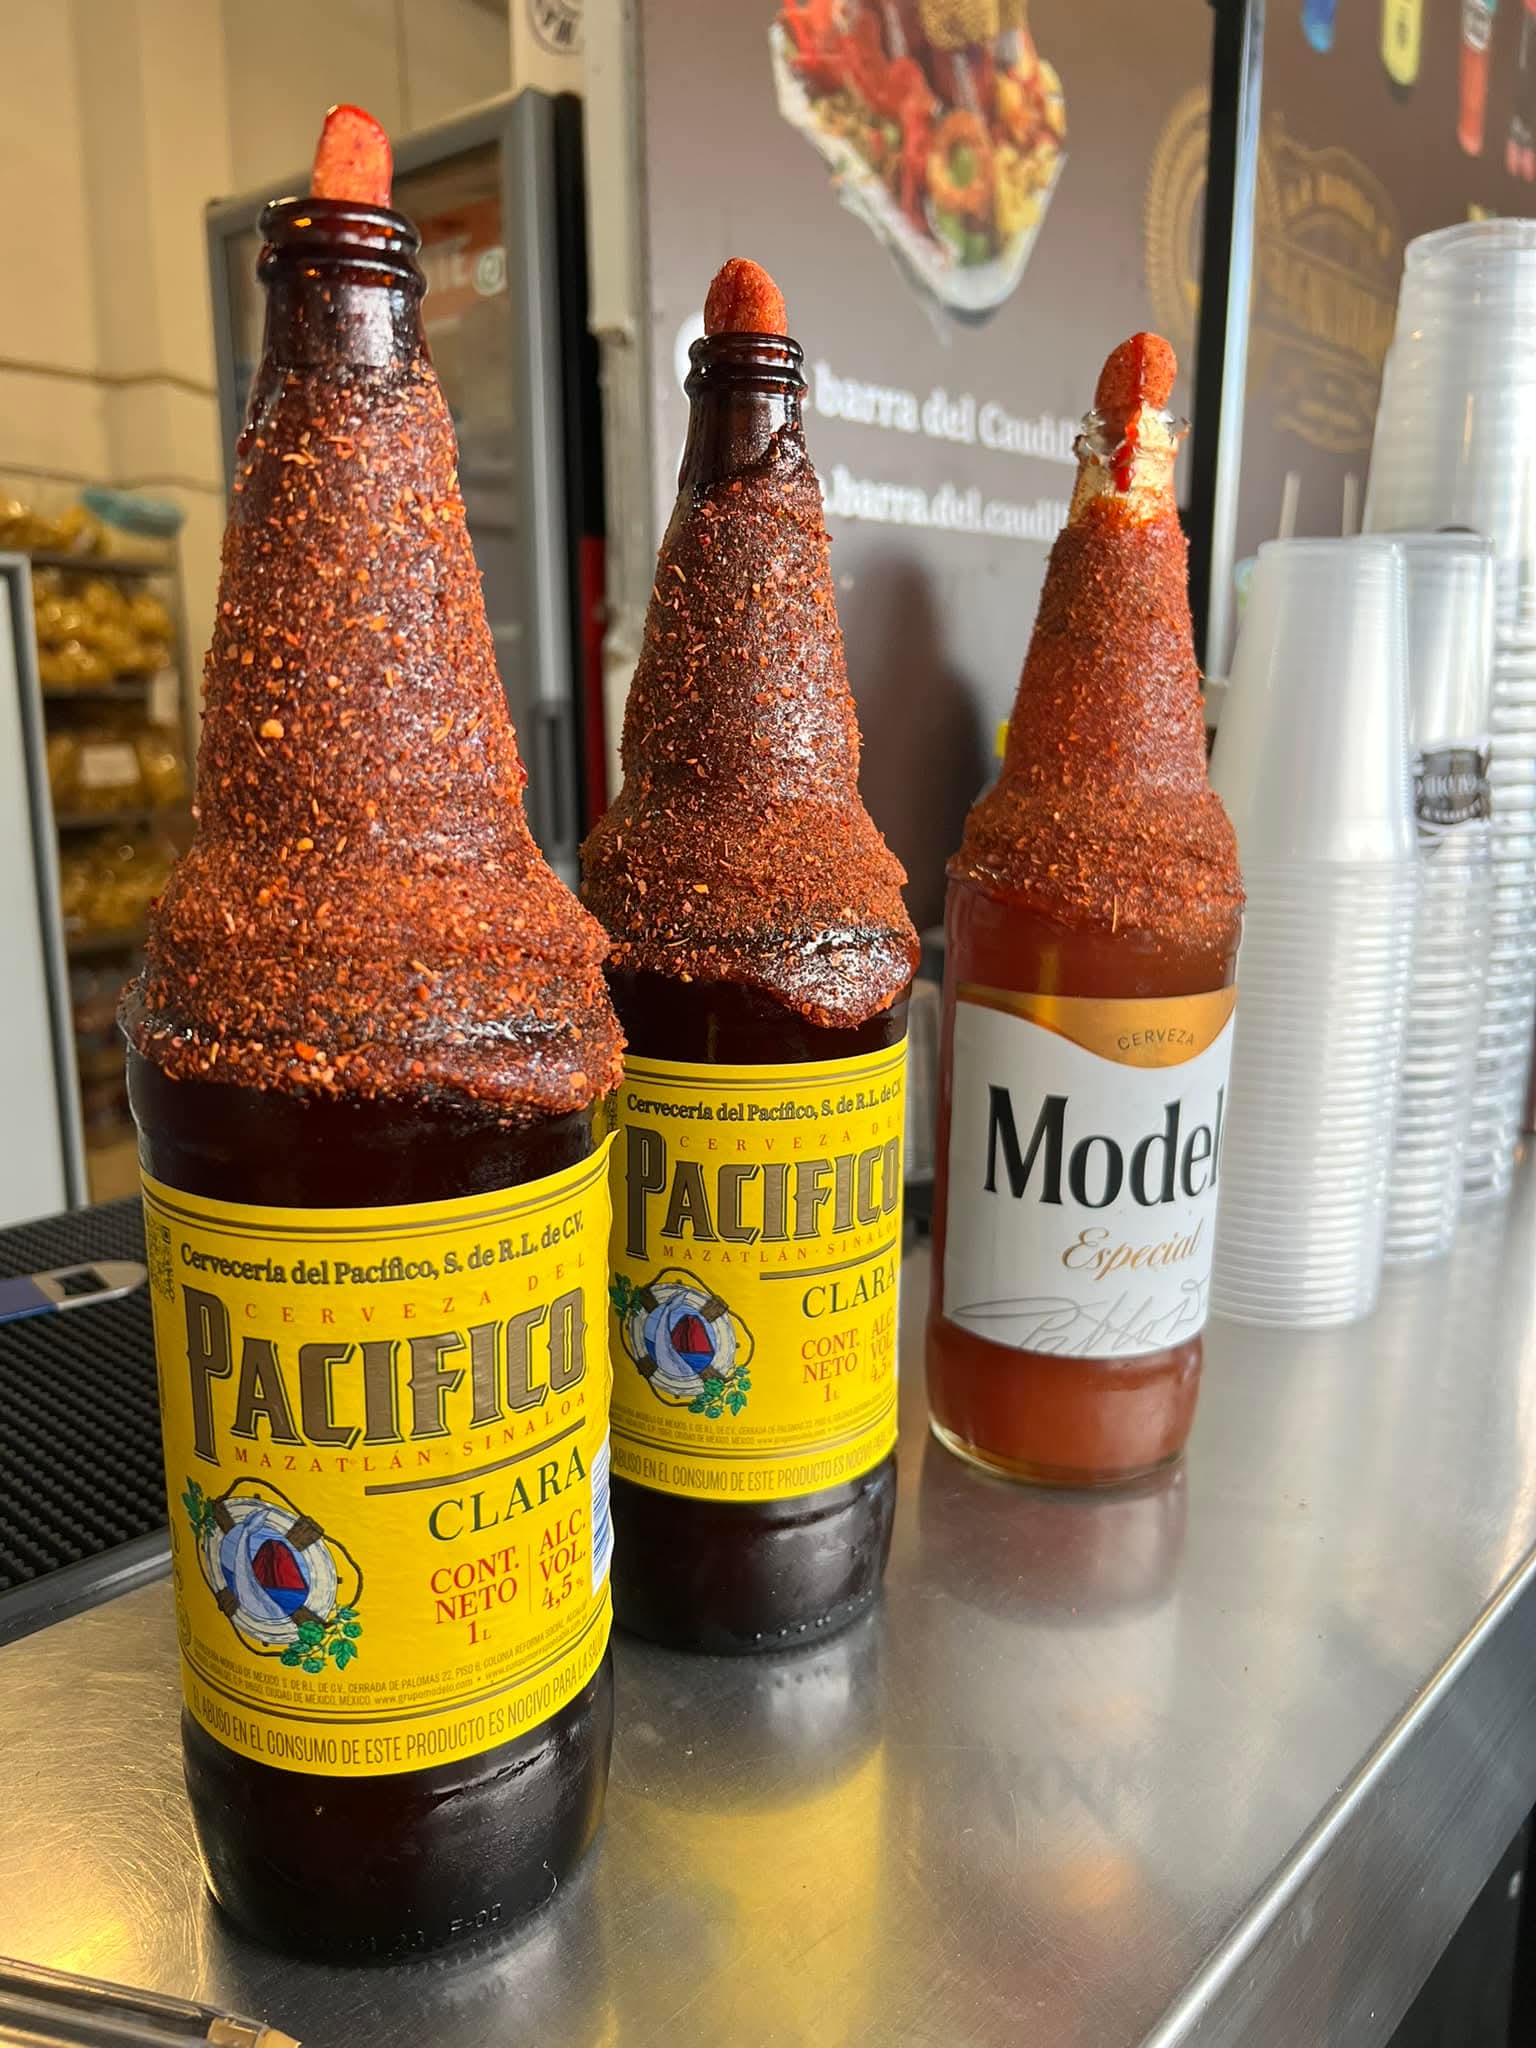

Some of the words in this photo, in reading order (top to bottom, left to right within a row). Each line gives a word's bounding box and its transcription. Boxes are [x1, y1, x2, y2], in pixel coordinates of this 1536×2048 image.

[1117, 1027, 1196, 1052] CERVEZA
[627, 1093, 713, 1120] Cervecería
[716, 1102, 744, 1122] del
[821, 1098, 834, 1117] S.
[836, 1094, 854, 1114] de
[680, 1130, 852, 1151] CERVEZA
[983, 1083, 1225, 1209] Model
[625, 1124, 901, 1261] PACIFICO
[180, 1242, 286, 1284] Cervecería
[291, 1260, 330, 1285] del
[334, 1257, 440, 1286] Pacífico,
[443, 1251, 464, 1275] S.
[467, 1243, 496, 1271] de
[498, 1232, 540, 1264] R.L.
[540, 1225, 562, 1251] de
[1061, 1218, 1206, 1282] Especial
[245, 1292, 492, 1324] CERVEZA
[528, 1253, 586, 1292] DEL
[802, 1257, 896, 1319] CLARA
[801, 1328, 860, 1360] CONT.
[803, 1352, 858, 1384] NETO
[181, 1284, 588, 1467] PACIFICO
[428, 1445, 587, 1542] CLARA
[643, 1458, 657, 1481] EN
[658, 1462, 670, 1484] EL
[672, 1464, 728, 1492] CONSUMO
[730, 1471, 746, 1492] DE
[748, 1470, 775, 1492] ESTE
[777, 1460, 833, 1489] PRODUCTO
[538, 1508, 587, 1556] ALC.
[430, 1546, 520, 1595] CONT.
[539, 1540, 587, 1583] VOL.
[434, 1577, 518, 1625] NETO
[348, 1680, 385, 1692] CERRADA
[389, 1678, 398, 1690] DE
[401, 1671, 439, 1688] PALOMAS
[455, 1663, 473, 1679] PISO
[483, 1648, 512, 1668] COLONIA
[202, 1695, 231, 1736] ABUSO
[233, 1715, 248, 1745] EN
[250, 1724, 264, 1752] EL
[266, 1730, 337, 1765] CONSUMO
[342, 1739, 361, 1765] DE
[365, 1736, 402, 1764] ESTE
[406, 1715, 485, 1756] PRODUCTO
[488, 1708, 505, 1737] ES
[507, 1683, 551, 1728] NOCIVO
[553, 1660, 577, 1699] PARA
[577, 1650, 589, 1681] LA
